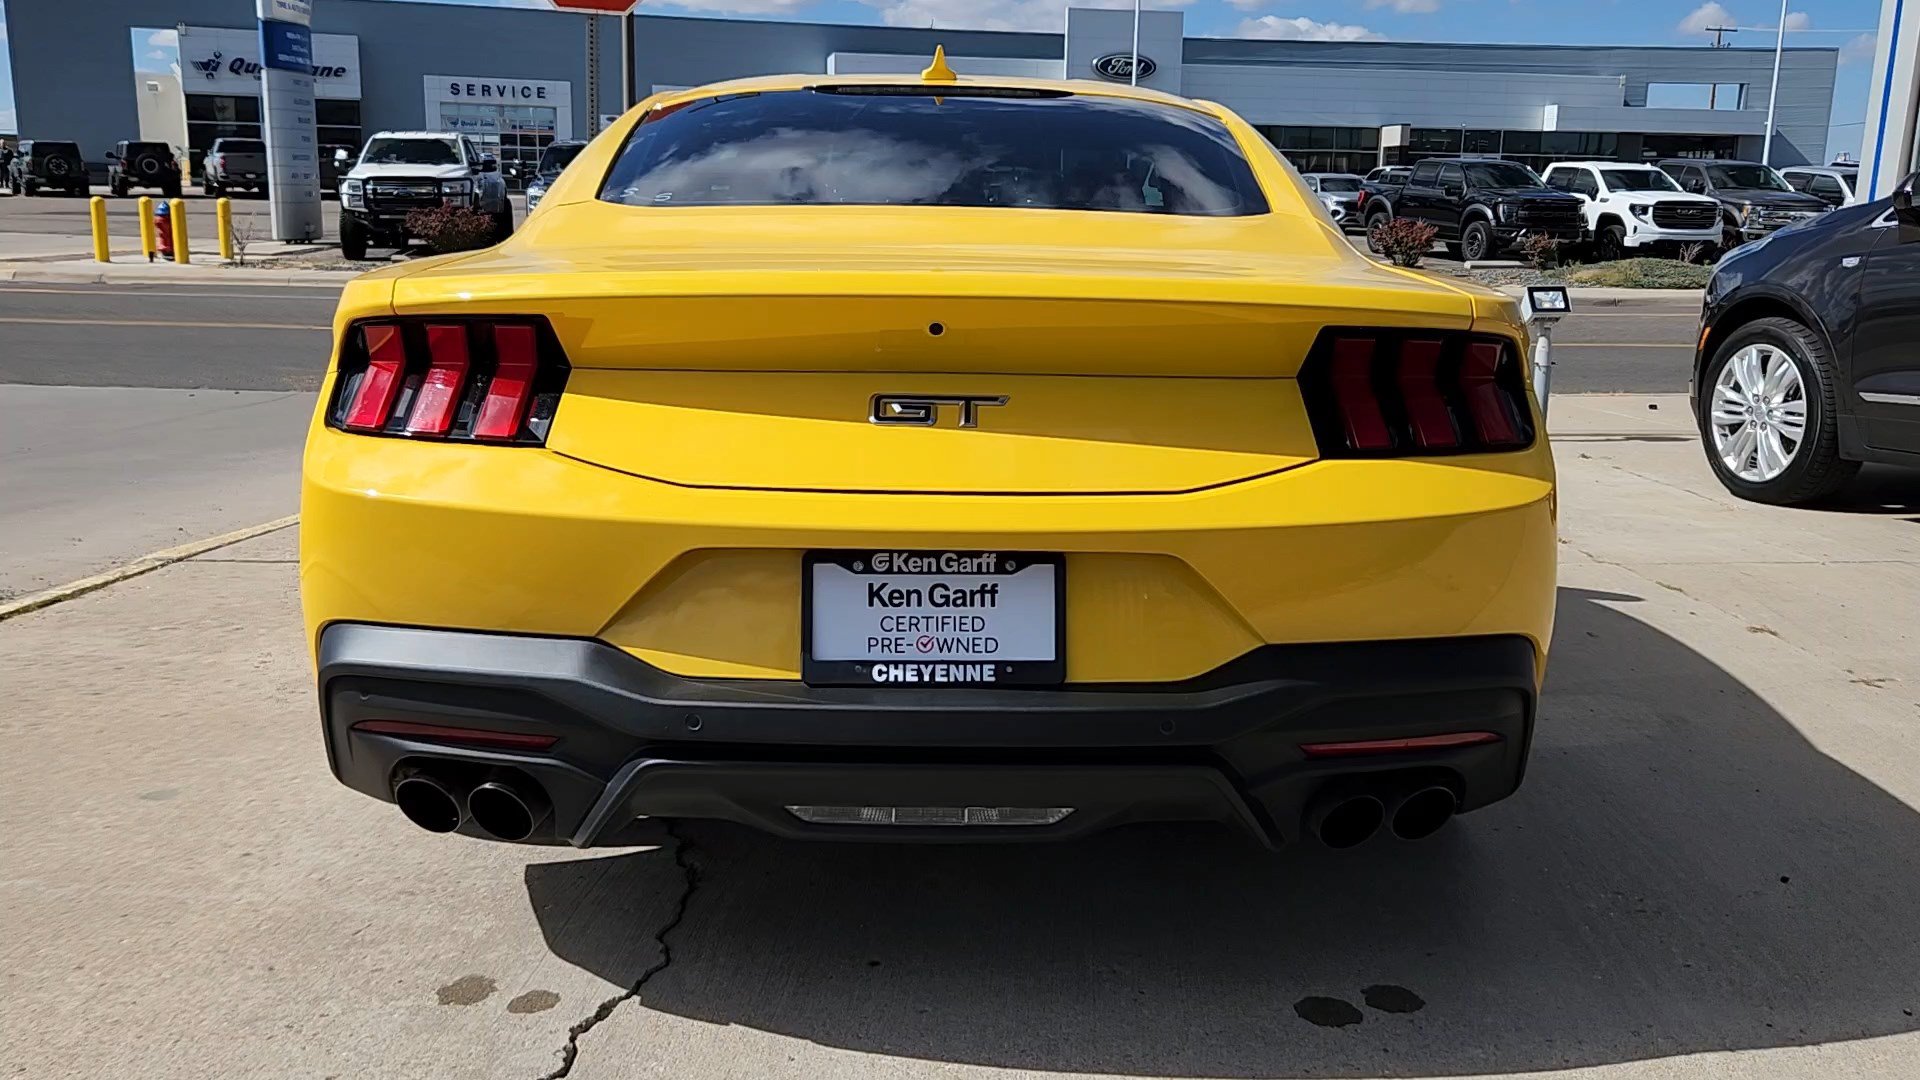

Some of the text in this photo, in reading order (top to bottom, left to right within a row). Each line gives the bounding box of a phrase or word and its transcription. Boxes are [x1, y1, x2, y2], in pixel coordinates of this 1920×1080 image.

[311, 65, 347, 78] ane
[450, 82, 547, 99] SERVICE
[868, 393, 1011, 428] GT
[893, 553, 997, 573] Ken Garff
[867, 582, 999, 608] Ken Garff
[880, 615, 986, 633] CERTIFIED
[872, 663, 996, 683] CHEYENNE
